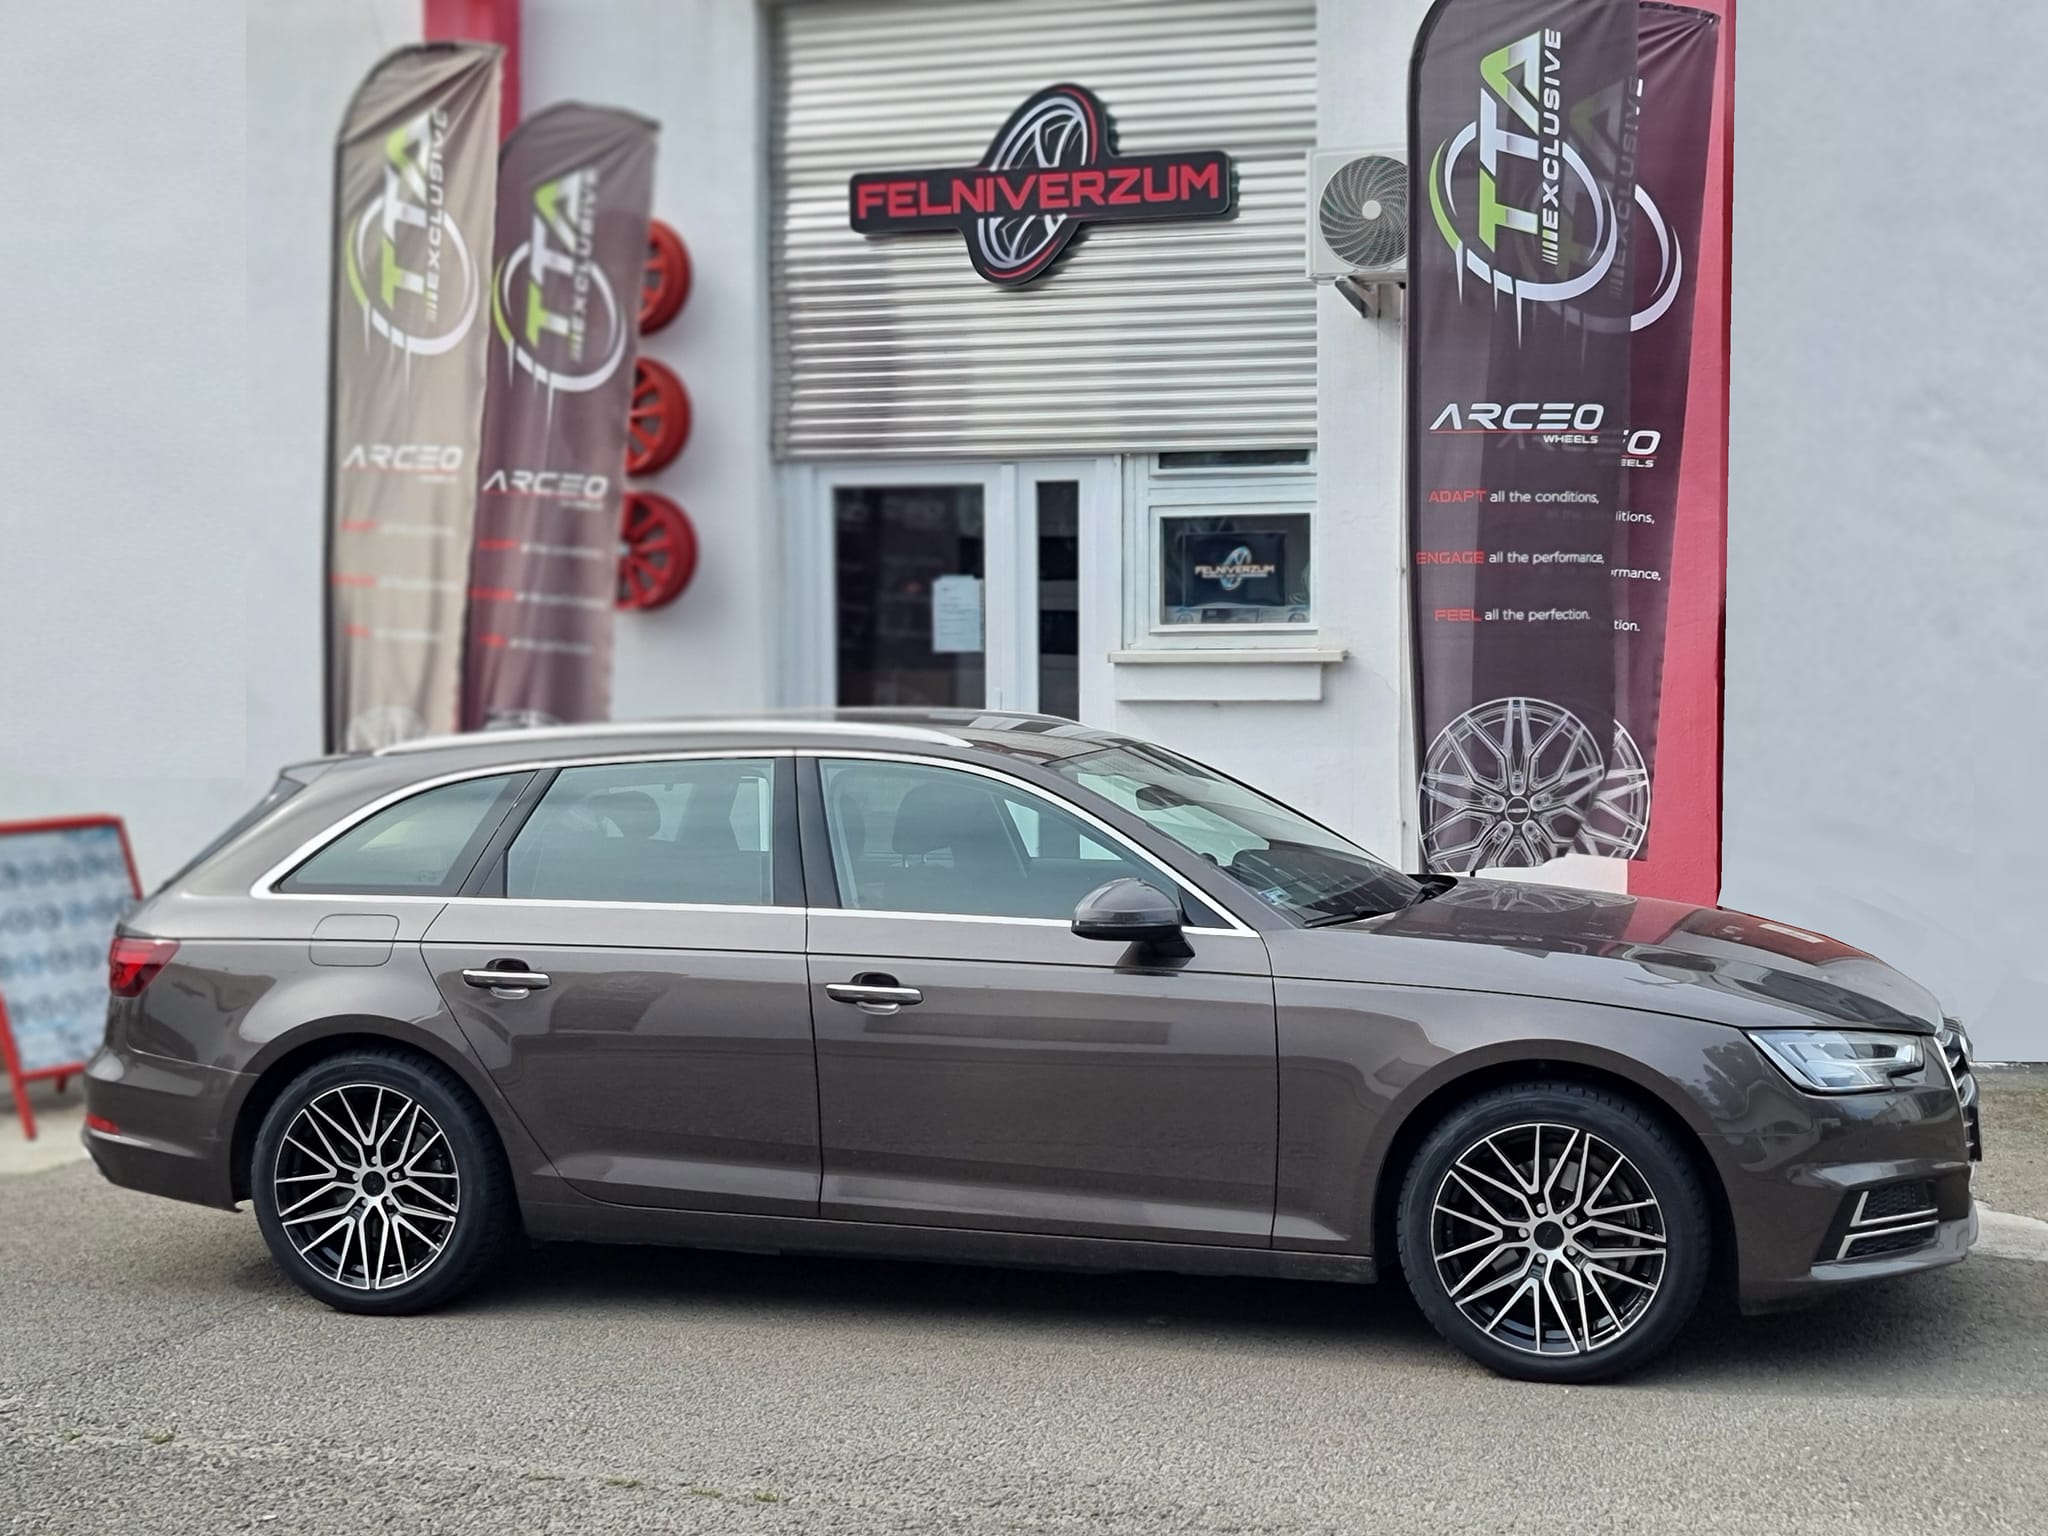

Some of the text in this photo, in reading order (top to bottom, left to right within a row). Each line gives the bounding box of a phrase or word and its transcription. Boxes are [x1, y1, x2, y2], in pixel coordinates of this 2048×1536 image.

[1479, 31, 1541, 253] TTA
[1543, 28, 1562, 231] EXCLUSIVE
[426, 105, 450, 304] EXCLUSIVE
[857, 162, 1219, 219] FELNIVERZUM
[381, 110, 434, 311] TTA
[526, 169, 582, 349] TTA
[1430, 403, 1604, 430] ARCEO
[1543, 435, 1599, 444] WHEELS
[343, 444, 464, 470] ARCEO
[483, 470, 609, 499] ARCEO
[1428, 490, 1599, 505] ADAPT all the conditions,
[1416, 551, 1605, 566] ENGAGE all the performance,
[1610, 567, 1661, 581] rmance,
[1434, 608, 1591, 623] FEEL all the perfection.
